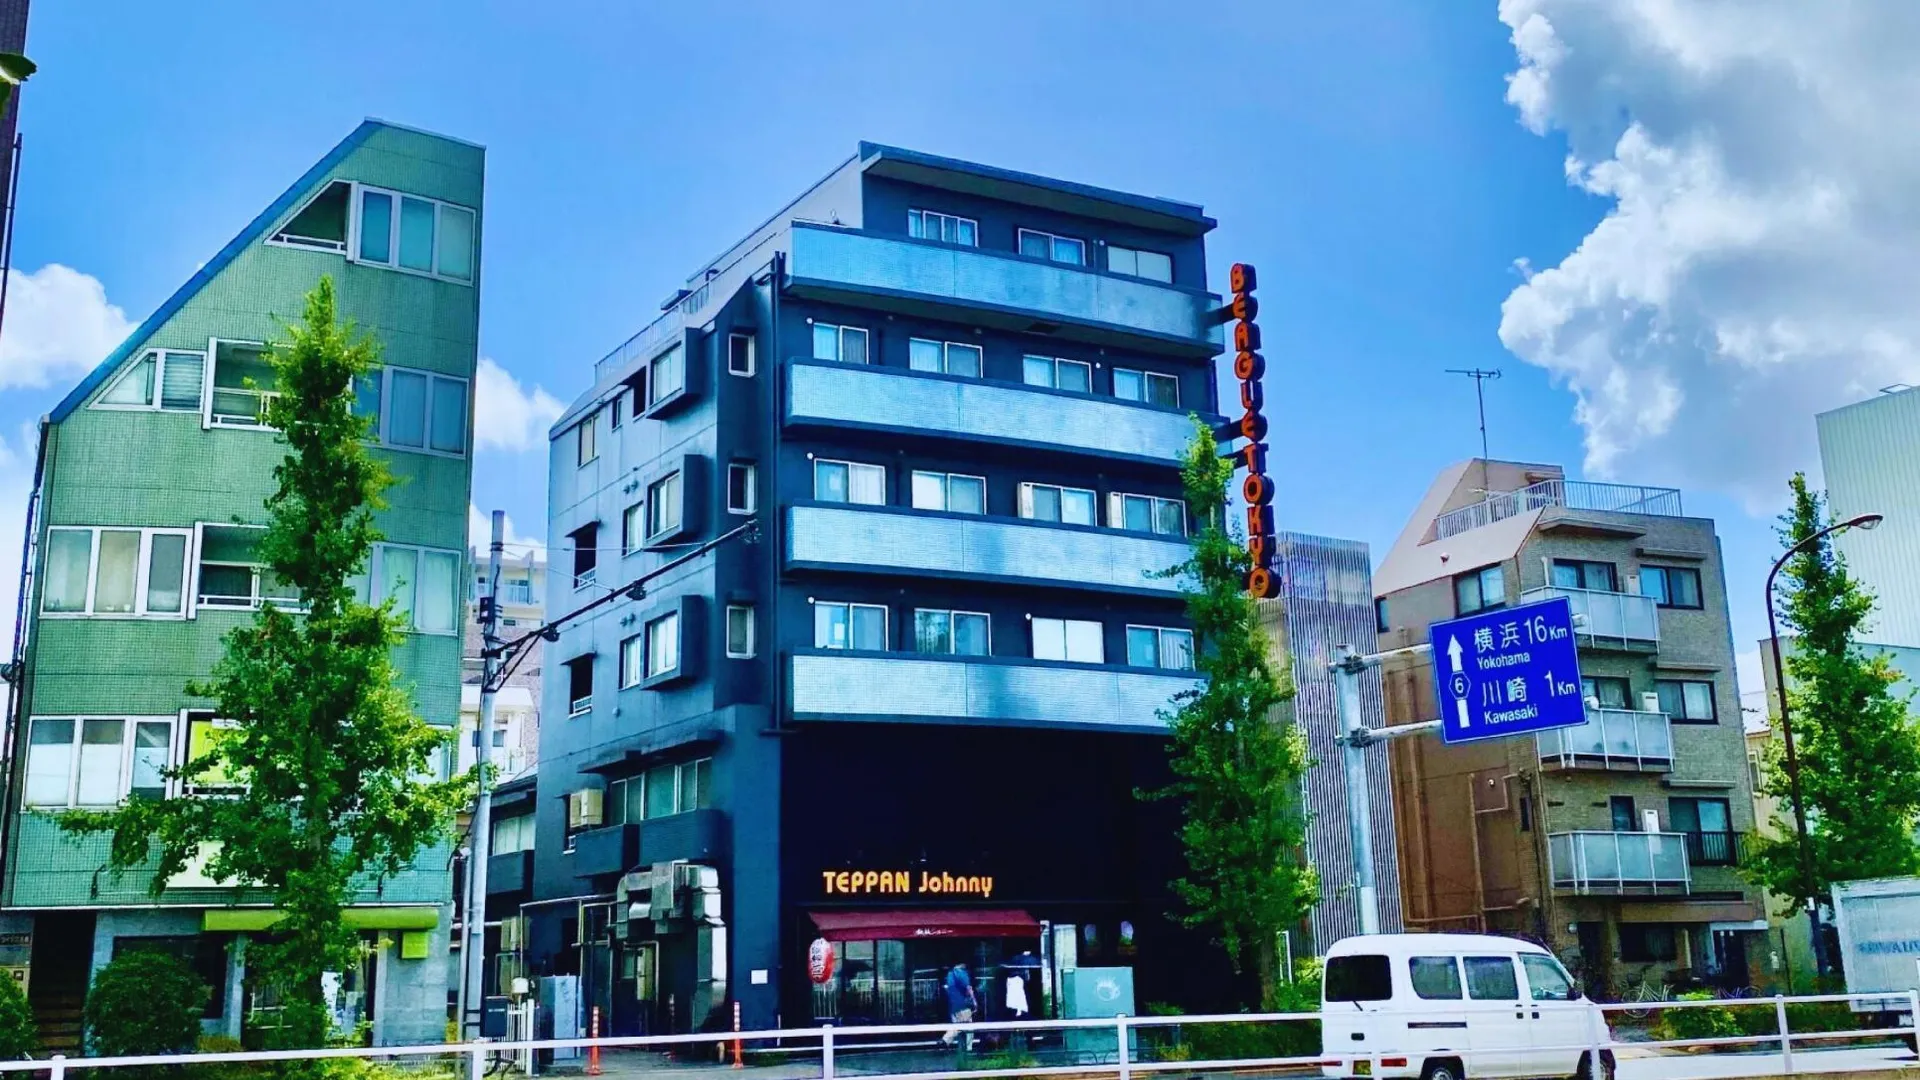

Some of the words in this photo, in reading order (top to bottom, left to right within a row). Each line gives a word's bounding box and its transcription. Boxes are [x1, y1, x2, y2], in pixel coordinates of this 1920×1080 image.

[1242, 443, 1279, 598] TOKYO
[1474, 621, 1521, 653] 横浜
[1524, 615, 1547, 644] 16
[1477, 652, 1530, 670] Yokohama
[1454, 677, 1464, 694] 6
[1482, 676, 1527, 707] 川崎
[1544, 670, 1554, 697] 1
[1484, 703, 1538, 725] Kawasaki
[822, 871, 910, 894] TEPPAN
[918, 871, 993, 898] Johnny
